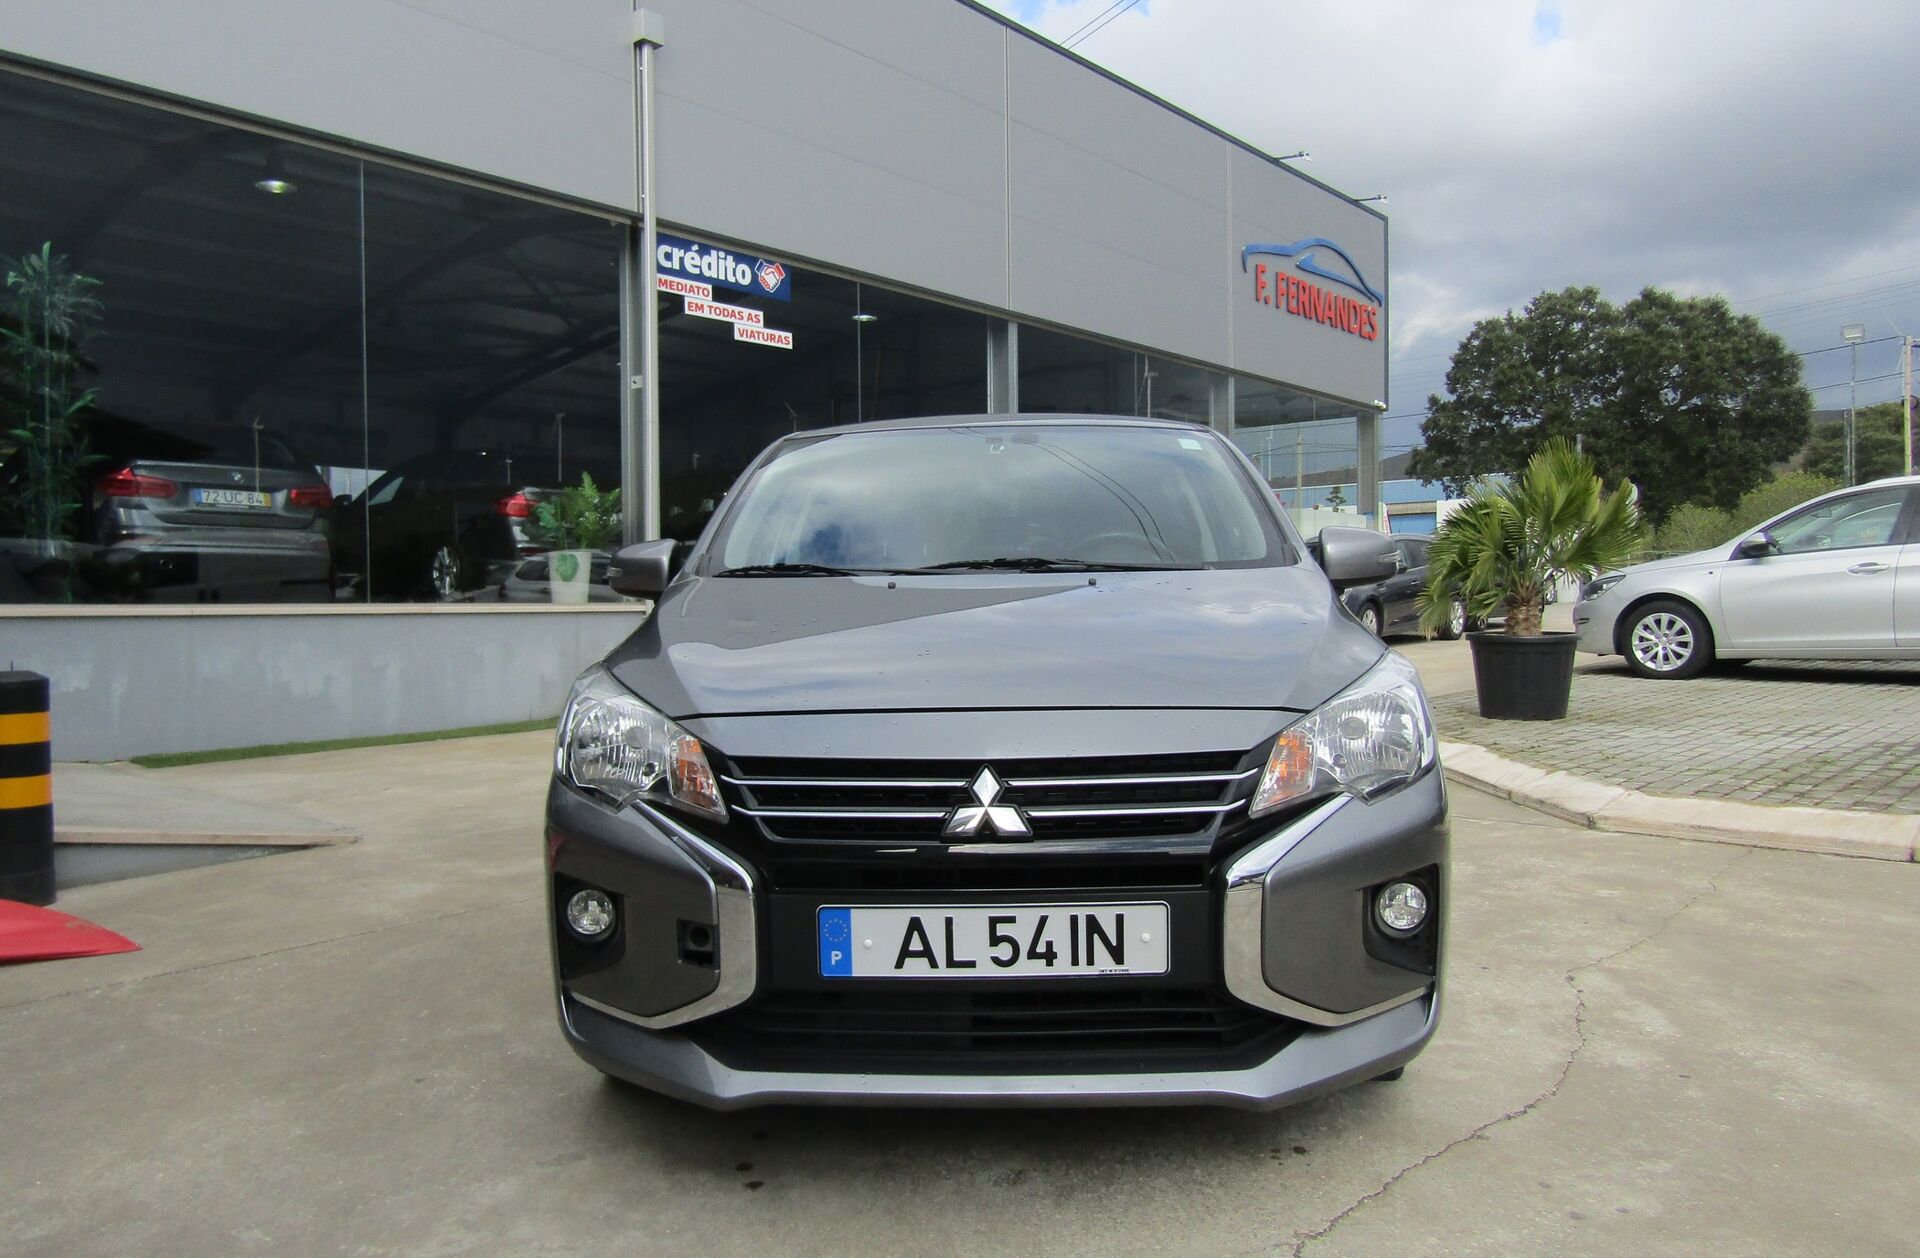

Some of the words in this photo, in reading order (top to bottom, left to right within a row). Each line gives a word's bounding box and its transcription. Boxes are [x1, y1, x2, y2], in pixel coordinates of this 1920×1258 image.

[657, 244, 752, 286] crédito
[658, 278, 710, 297] MEDIATO
[687, 301, 704, 313] EM
[707, 304, 744, 320] TODAS
[746, 312, 761, 324] AS
[1255, 264, 1271, 305] F.
[1276, 272, 1377, 341] FERNANDES
[738, 327, 790, 345] VIATURAS
[831, 951, 842, 966] P
